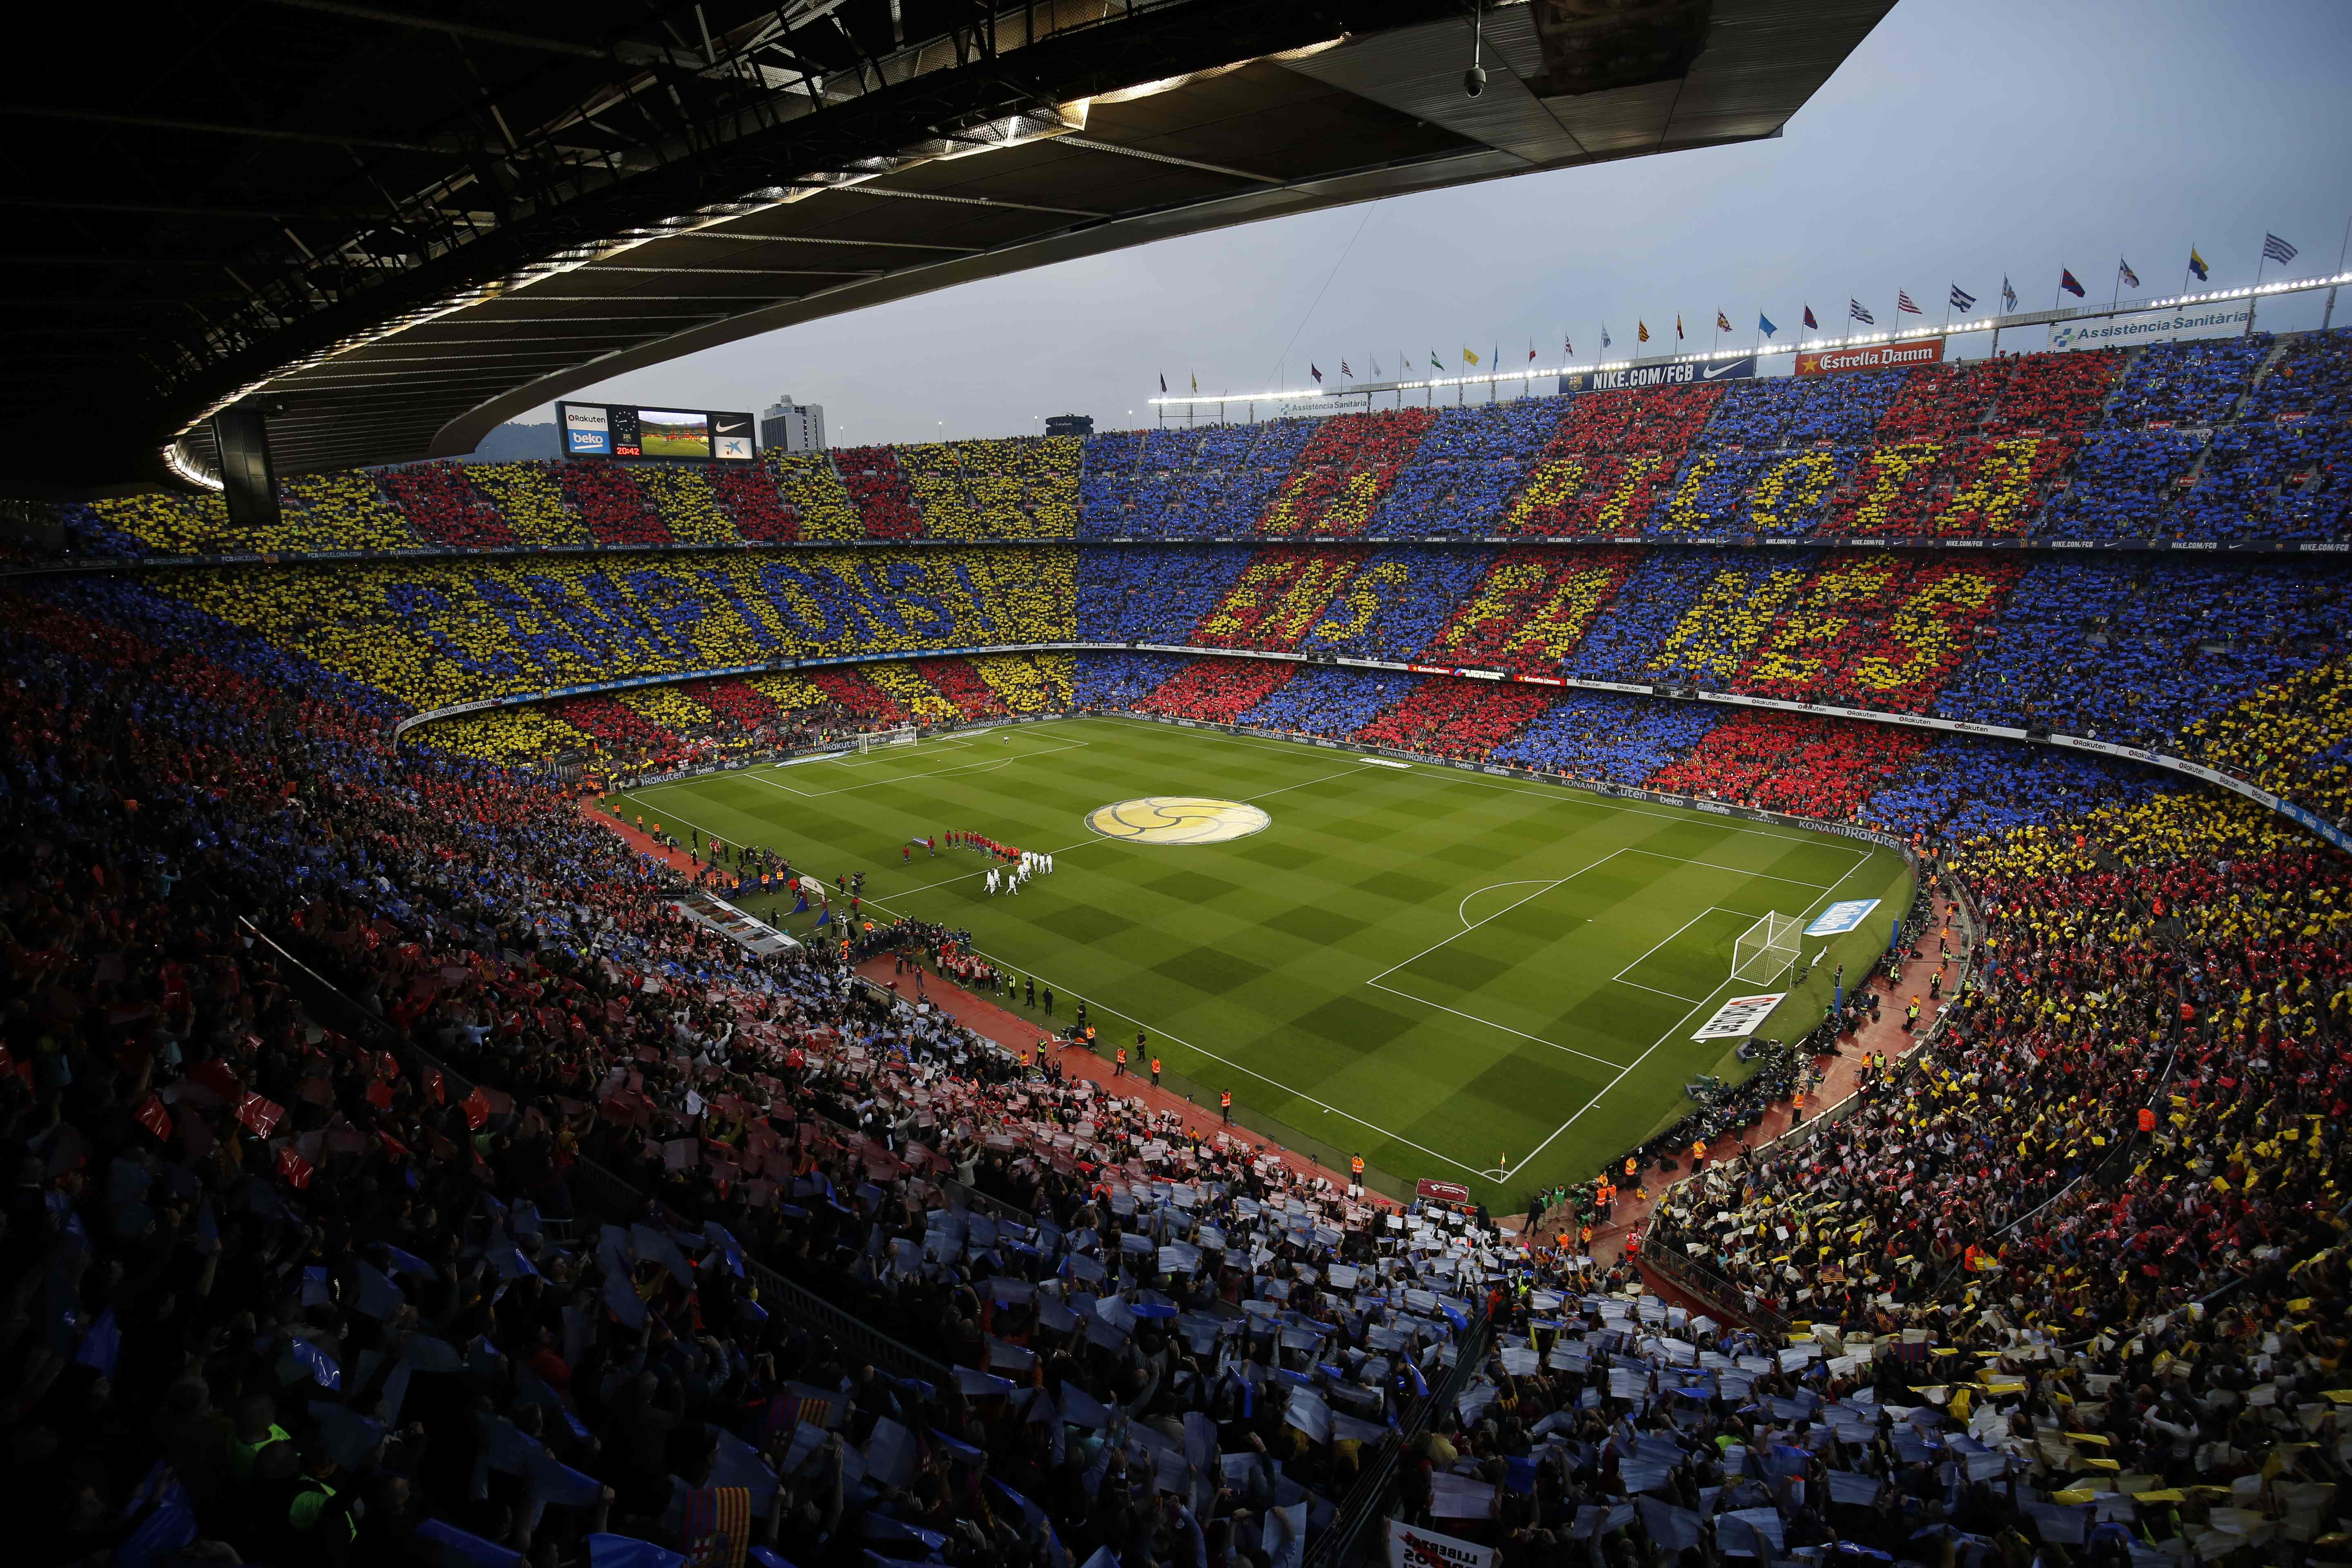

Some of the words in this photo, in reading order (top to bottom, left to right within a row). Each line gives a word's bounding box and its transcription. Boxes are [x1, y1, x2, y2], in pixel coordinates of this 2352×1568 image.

[2077, 321, 2170, 339] Assistència
[2173, 312, 2248, 330] Sanitària
[1820, 350, 1879, 370] Estrella
[1880, 347, 1933, 365] Damm
[1593, 364, 1694, 390] NIKE.COM/FCB
[1292, 402, 1333, 412] Assistència
[1334, 399, 1367, 409] Sanitària
[575, 415, 606, 423] Rakuten
[573, 432, 603, 444] beko
[617, 447, 640, 455] 20:42
[1434, 666, 1450, 674] Damm
[1524, 675, 1543, 684] Estrella
[1543, 677, 1560, 685] Damm
[465, 699, 492, 710] KONAMI
[1802, 705, 1826, 713] Rakuten
[434, 707, 457, 717] KONAMI
[1126, 712, 1152, 722] Rakuten
[1852, 710, 1877, 719] Rakuten
[412, 713, 429, 724] KONAMI
[981, 718, 1012, 728] Rakuten
[1904, 716, 1931, 726] Rakuten
[953, 723, 979, 732] KONAMI
[1230, 727, 1253, 736] KAMI
[1960, 723, 1988, 733] Rakuten
[1254, 729, 1285, 741] Rakuten
[1293, 735, 1308, 744] beko
[826, 740, 861, 752] Rakuten
[1316, 739, 1337, 748] Gillette
[2078, 740, 2106, 751] Rakuten
[794, 746, 824, 757] KONAMI
[1378, 748, 1405, 759] KONAMI
[2134, 751, 2148, 760] Raku
[1409, 753, 1446, 766] Rakuten
[695, 765, 715, 775] beko
[1455, 760, 1474, 771] beko
[2183, 762, 2204, 776] Rakuten
[1483, 766, 1510, 777] Gillette
[644, 770, 685, 786] Rakuten
[2221, 776, 2239, 790] Rakuten
[1561, 778, 1596, 791] KONAMI
[1600, 784, 1647, 800] Ruten
[2254, 790, 2271, 804] Rakuten
[1659, 794, 1684, 807] beko
[1696, 802, 1731, 815] Gillette
[2281, 802, 2296, 817] beko
[2302, 813, 2316, 829] beko
[1798, 820, 1844, 836] KONAMI
[2322, 824, 2336, 840] beko
[1850, 828, 1900, 851] Rakuten
[2342, 836, 2352, 851] bek
[1700, 1002, 1771, 1036] Rakuten
